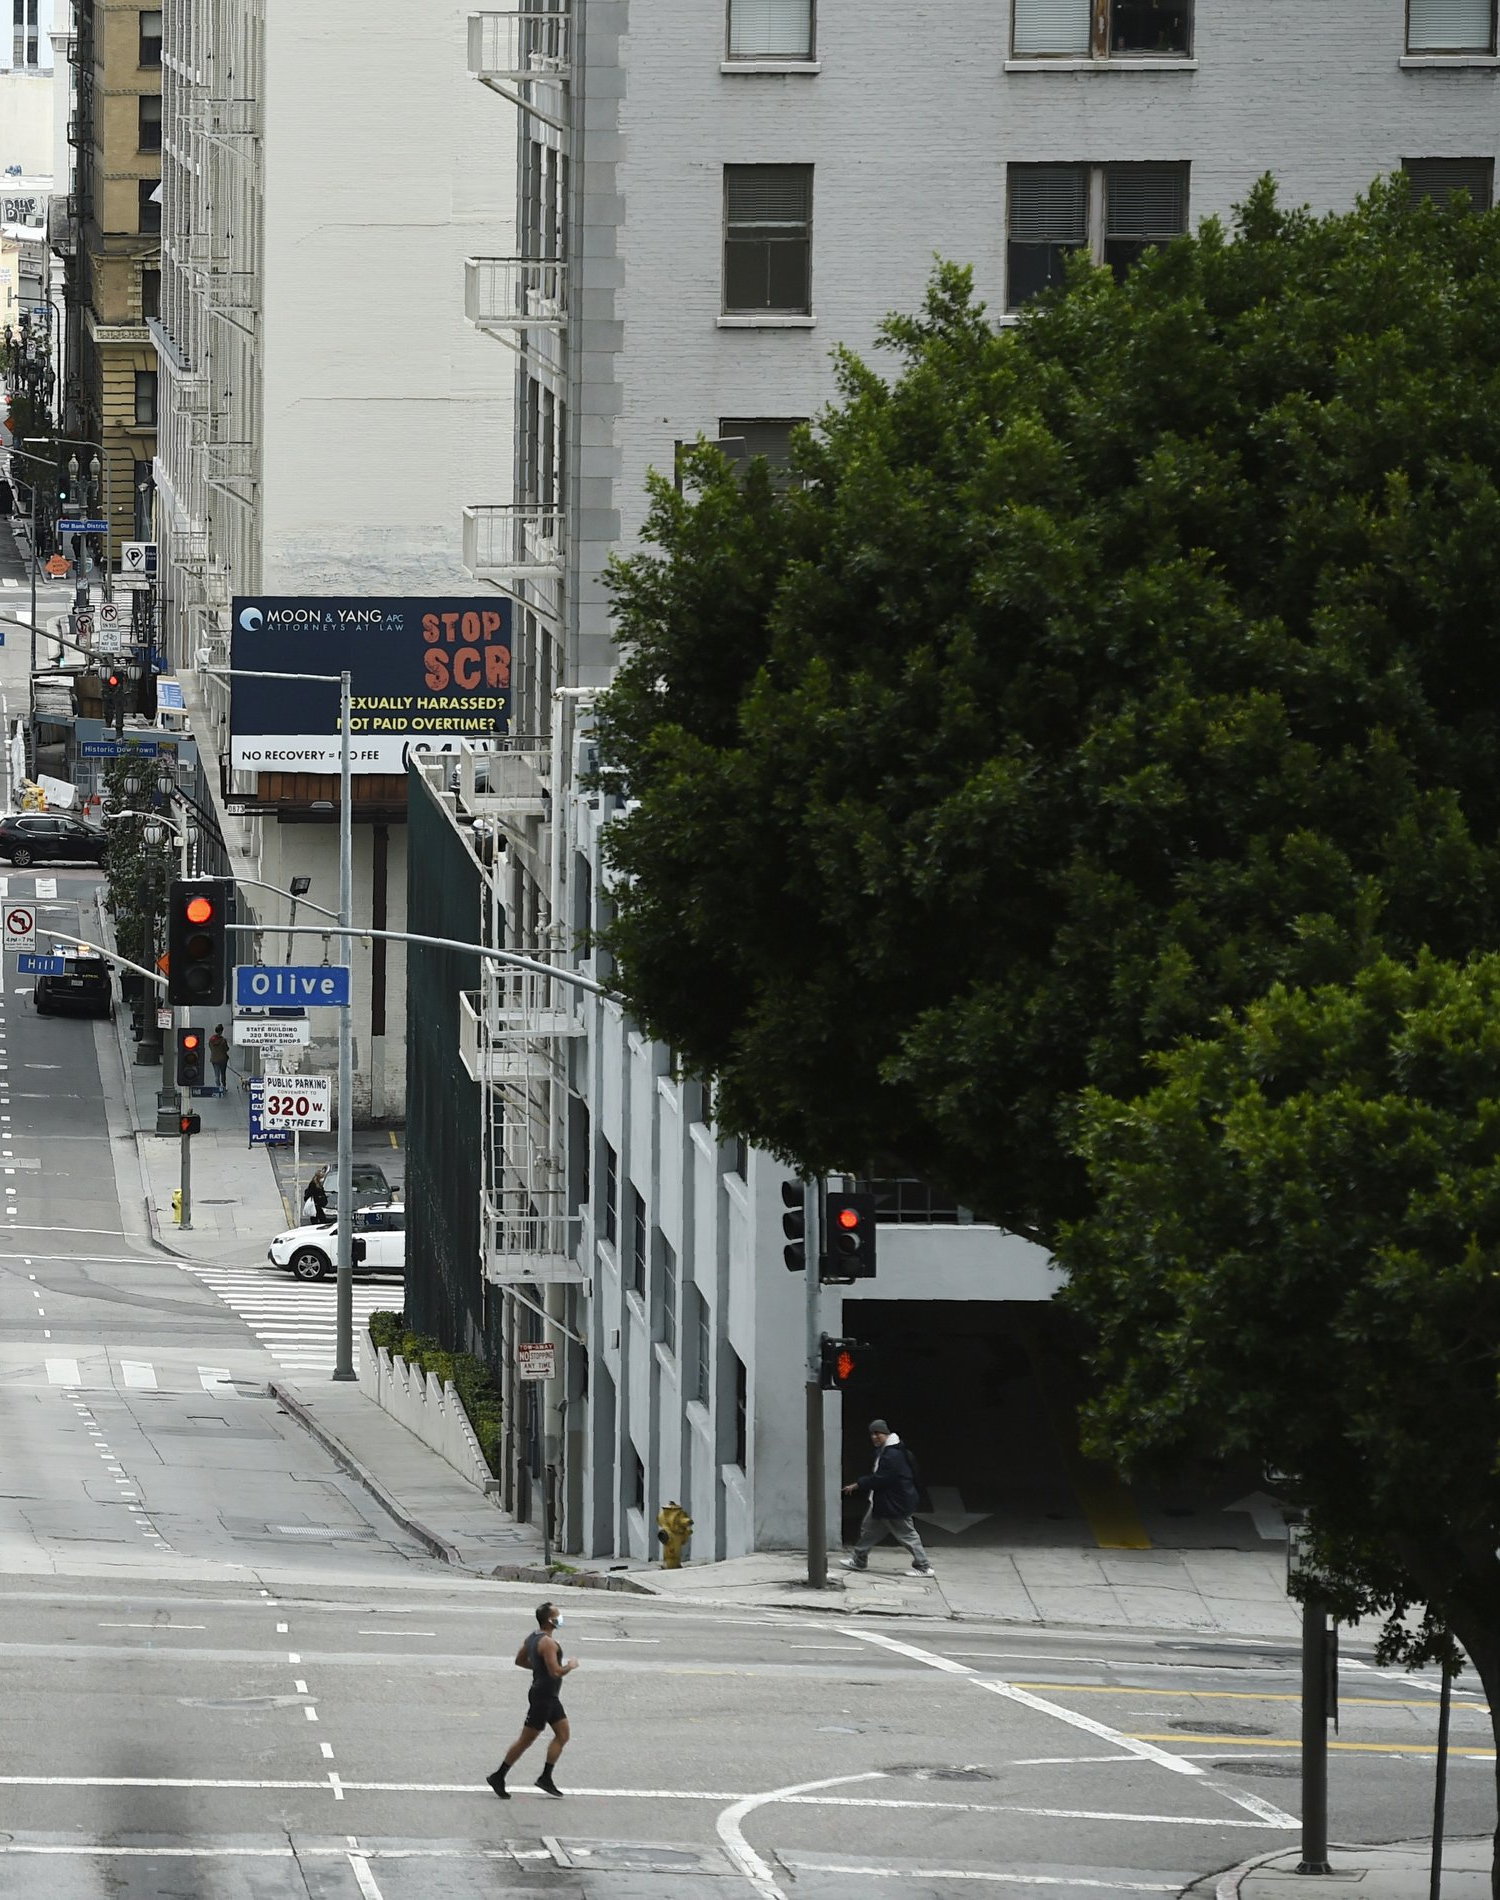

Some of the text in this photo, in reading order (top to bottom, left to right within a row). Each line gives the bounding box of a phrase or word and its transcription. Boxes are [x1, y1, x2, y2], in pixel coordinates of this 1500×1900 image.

[266, 609, 321, 623] MOON
[324, 613, 333, 623] &
[386, 614, 404, 623] APC
[267, 623, 404, 632] ATTORNEYS AT LAW
[421, 611, 501, 643] STOP
[424, 645, 511, 692] SCR
[417, 697, 505, 710] HARASSED?
[373, 718, 408, 730] PAID
[411, 718, 495, 731] OVERTIME?
[84, 745, 114, 753] Historic
[241, 751, 262, 761] NO
[264, 750, 326, 760] RECOVERY
[361, 750, 380, 760] FEE
[228, 804, 245, 813] 0873
[27, 958, 54, 970] Hill
[252, 973, 335, 995] Olive
[267, 1077, 327, 1090] PUBLIC PARKING
[267, 1095, 326, 1116] 320 W.
[284, 1118, 324, 1128] STREET
[520, 1351, 553, 1361] NO STOPPING
